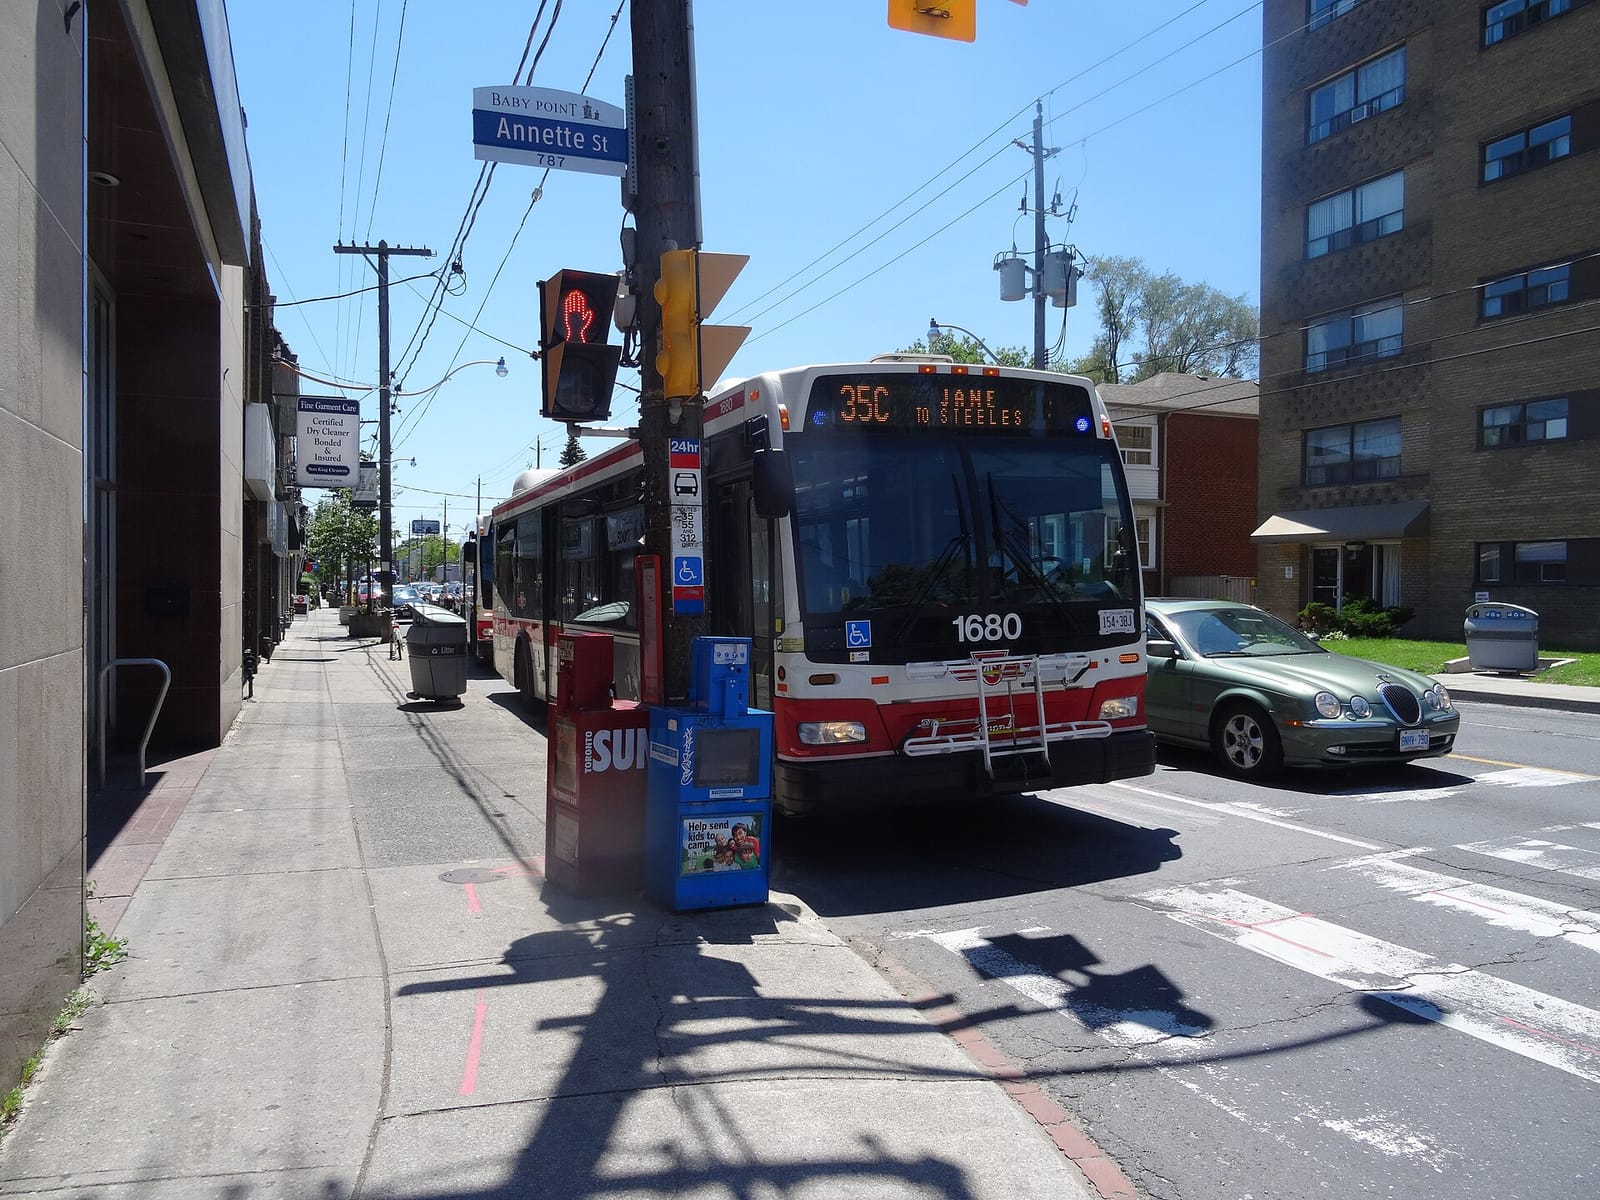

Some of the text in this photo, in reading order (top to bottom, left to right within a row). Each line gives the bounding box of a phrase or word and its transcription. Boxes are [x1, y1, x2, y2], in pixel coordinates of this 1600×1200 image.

[497, 117, 608, 153] Annette St
[537, 153, 566, 168] 787
[300, 400, 357, 412] Fine Garment Care
[720, 397, 733, 415] 1680
[840, 385, 996, 422] 35C JANE
[312, 416, 344, 427] Certified
[916, 407, 1022, 425] TO STEELES
[306, 426, 350, 437] Dry Cleaner
[314, 437, 342, 447] Bonded
[671, 440, 699, 453] 24hr
[323, 446, 332, 455] &
[314, 453, 342, 462] Insured
[681, 512, 694, 521] 35
[681, 521, 694, 529] 55
[680, 533, 696, 543] 312
[953, 614, 1022, 642] 1680
[584, 731, 593, 774] TORONTO
[688, 820, 729, 832] Help send
[688, 831, 716, 841] kids to
[688, 841, 710, 849] camp
